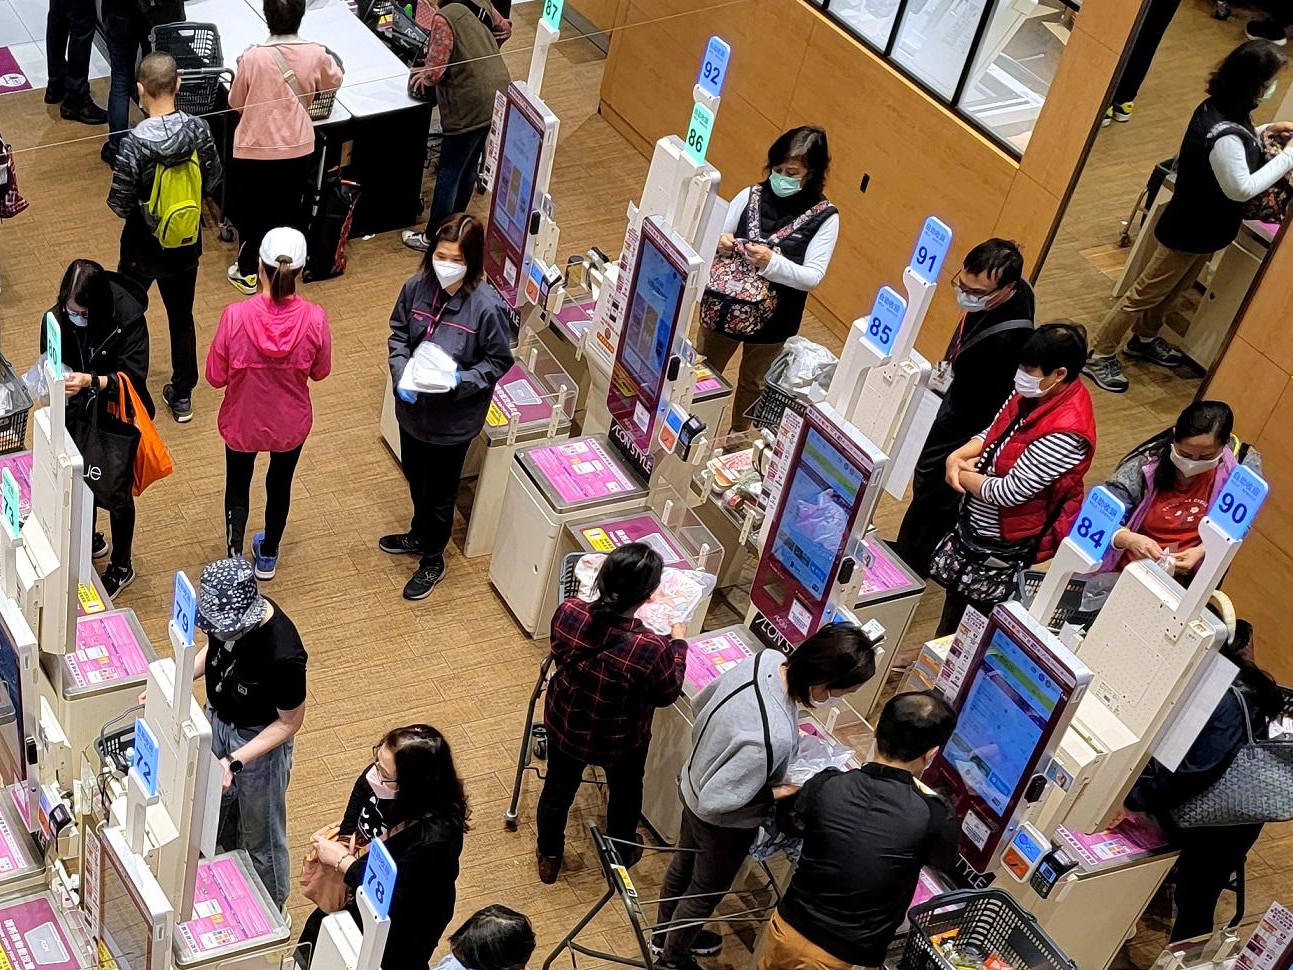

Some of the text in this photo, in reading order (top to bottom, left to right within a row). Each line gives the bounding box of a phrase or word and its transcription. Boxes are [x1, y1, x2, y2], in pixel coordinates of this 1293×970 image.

[545, 0, 558, 21] 87
[703, 61, 720, 86] 92
[688, 128, 704, 153] 86
[916, 246, 937, 273] 91
[869, 317, 892, 345] 85
[49, 338, 58, 366] 80
[612, 425, 653, 475] AEON STYLE
[3, 495, 14, 526] 73
[1218, 492, 1248, 525] 90
[1076, 516, 1106, 550] 84
[176, 600, 188, 633] 79
[136, 748, 151, 785] 72
[367, 866, 385, 905] 78
